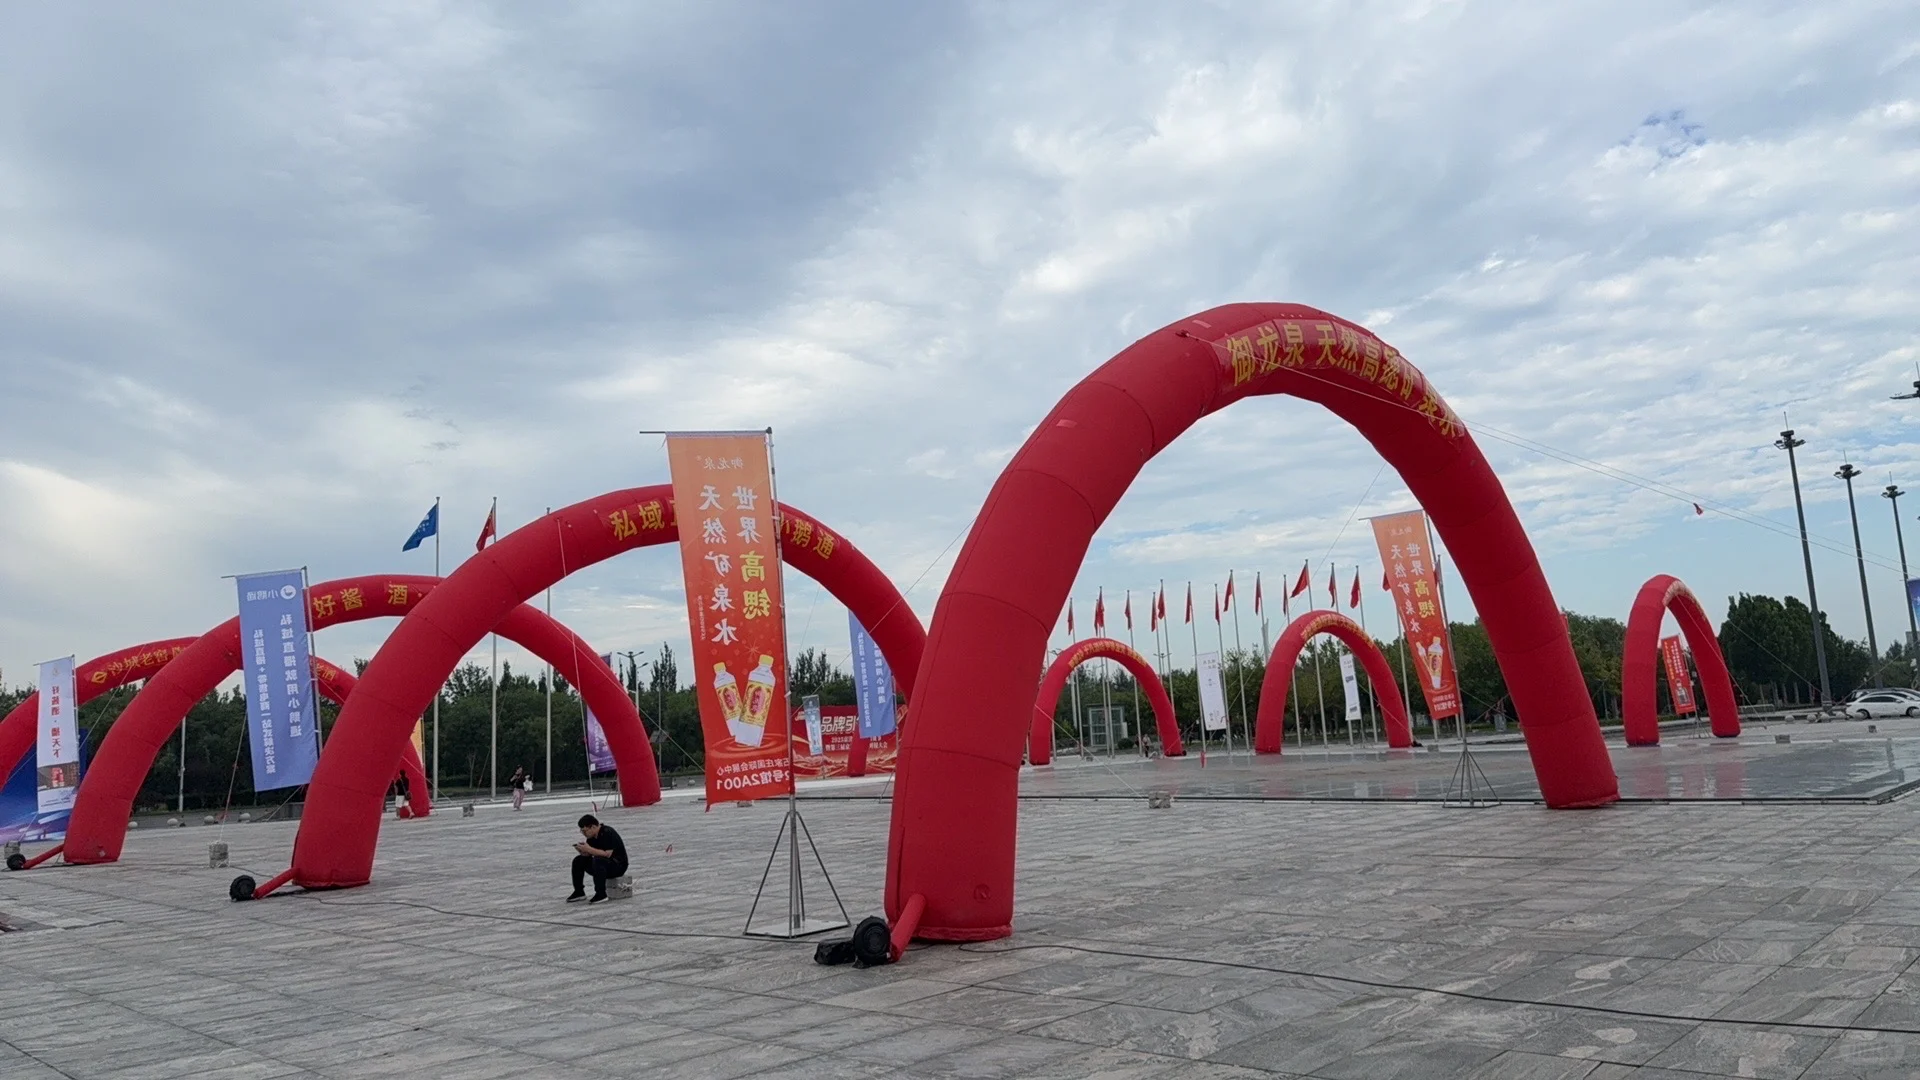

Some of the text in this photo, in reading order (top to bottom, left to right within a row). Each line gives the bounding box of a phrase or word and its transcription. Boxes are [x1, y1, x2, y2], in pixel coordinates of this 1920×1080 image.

[1227, 322, 1302, 387] 御龙泉
[608, 500, 676, 541] 私域
[820, 714, 859, 732] 品牌引
